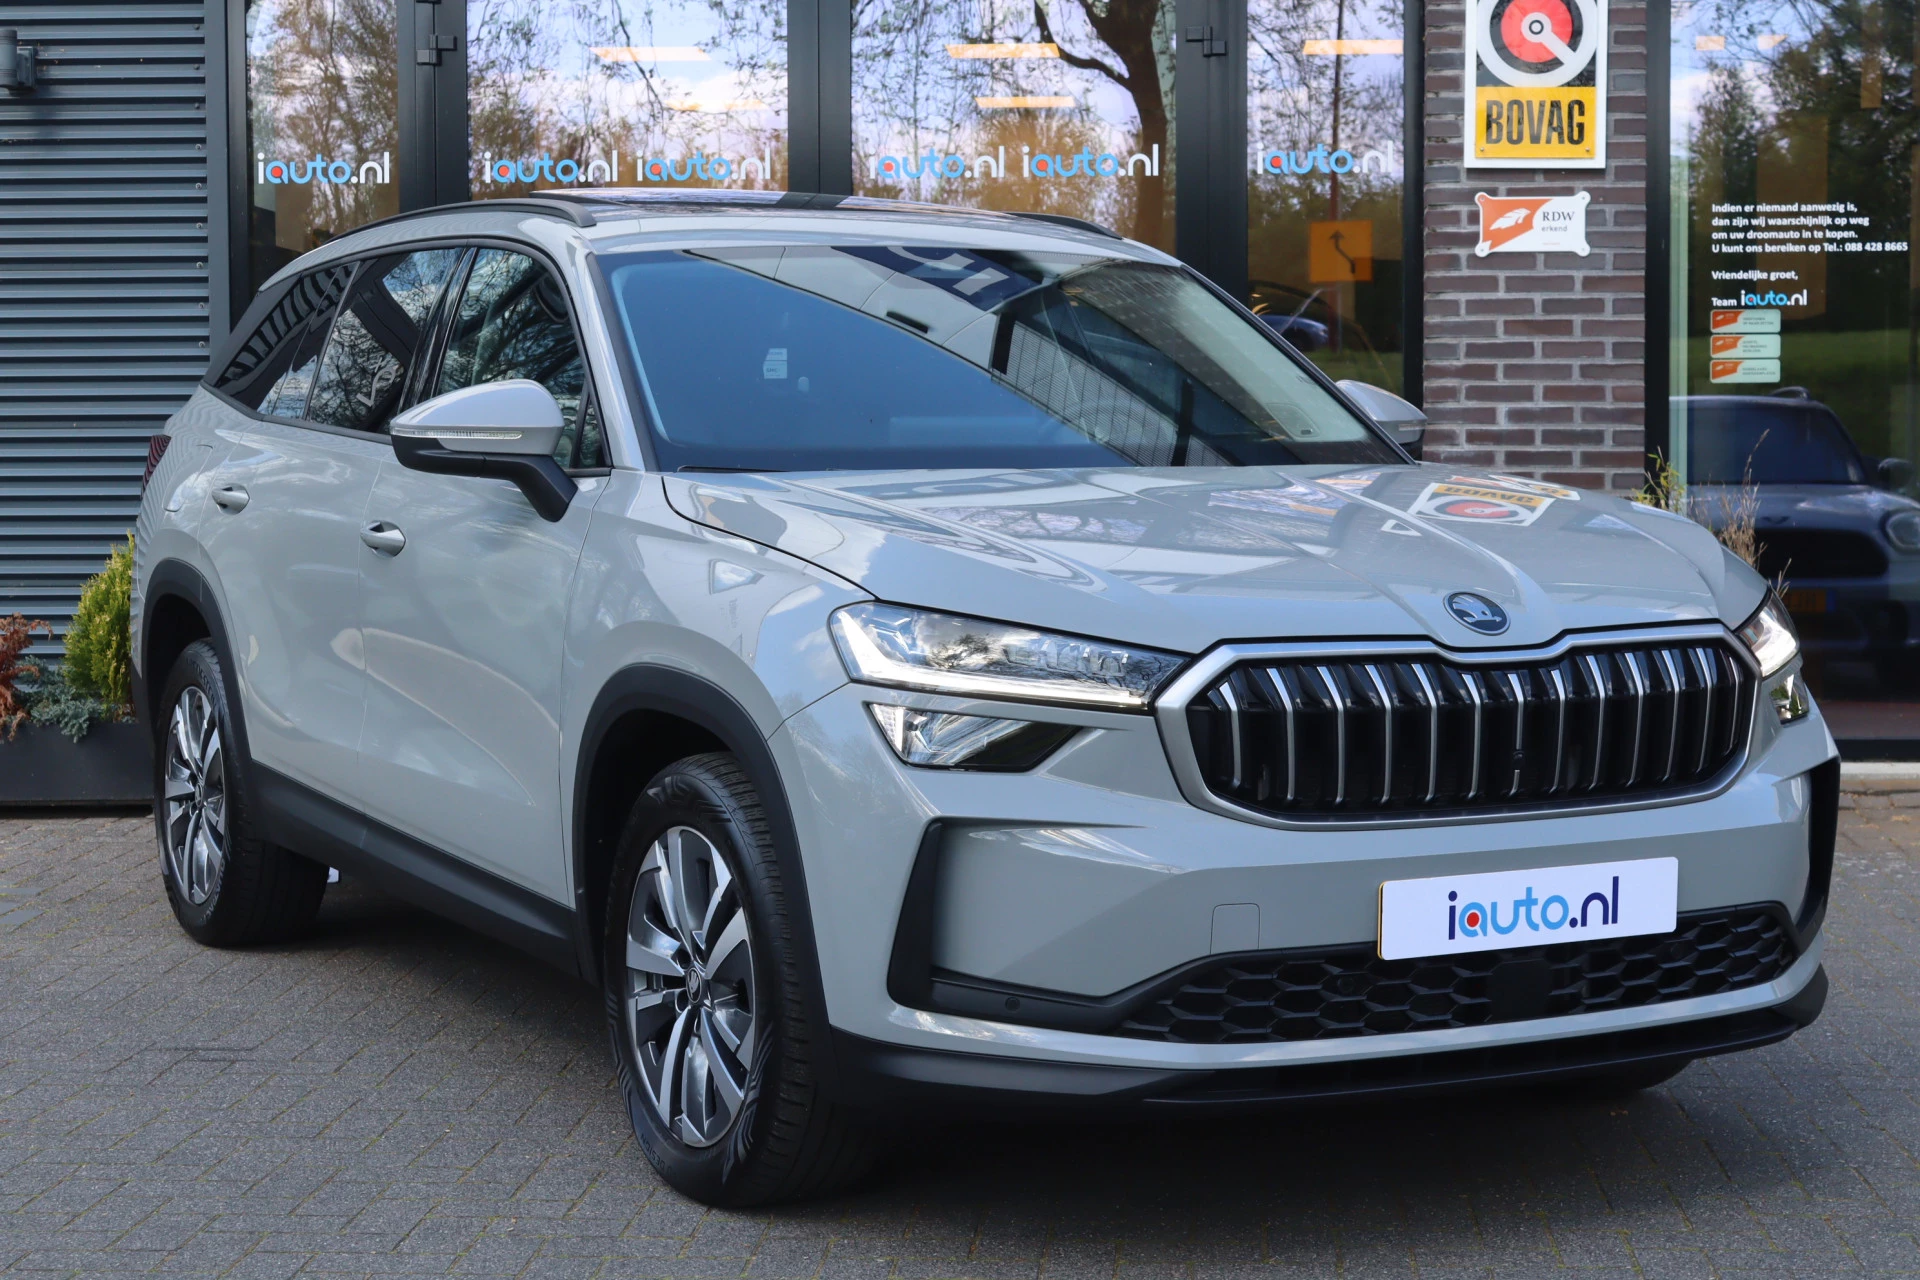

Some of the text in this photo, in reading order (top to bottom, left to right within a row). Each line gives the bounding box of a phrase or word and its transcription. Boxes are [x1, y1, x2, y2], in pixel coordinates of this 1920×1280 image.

[1485, 98, 1586, 145] BOVAG
[257, 151, 390, 185] iauto.nl
[483, 149, 619, 184] iauto.nl
[637, 148, 771, 182] iauto.nl
[869, 145, 1006, 180] iauto.nl
[1023, 143, 1159, 178] iauto.nl
[1256, 140, 1393, 175] iauto.nl
[1542, 211, 1575, 222] RDW
[1712, 201, 1858, 213] Indien er niemand aanwezig is,
[1712, 215, 1870, 228] dan zijn wij waarschijnlijk op weg
[1711, 241, 1908, 254] U kunt ons bereiken op Tel.: 088 428 8665
[1712, 229, 1858, 240] om uw droomauto in te kopen.
[1711, 270, 1798, 282] Vriendelijke groet,
[1711, 288, 1808, 307] Team iauto.nl
[1448, 875, 1620, 941] iauto.nl
[640, 1132, 666, 1169] DESIGN
